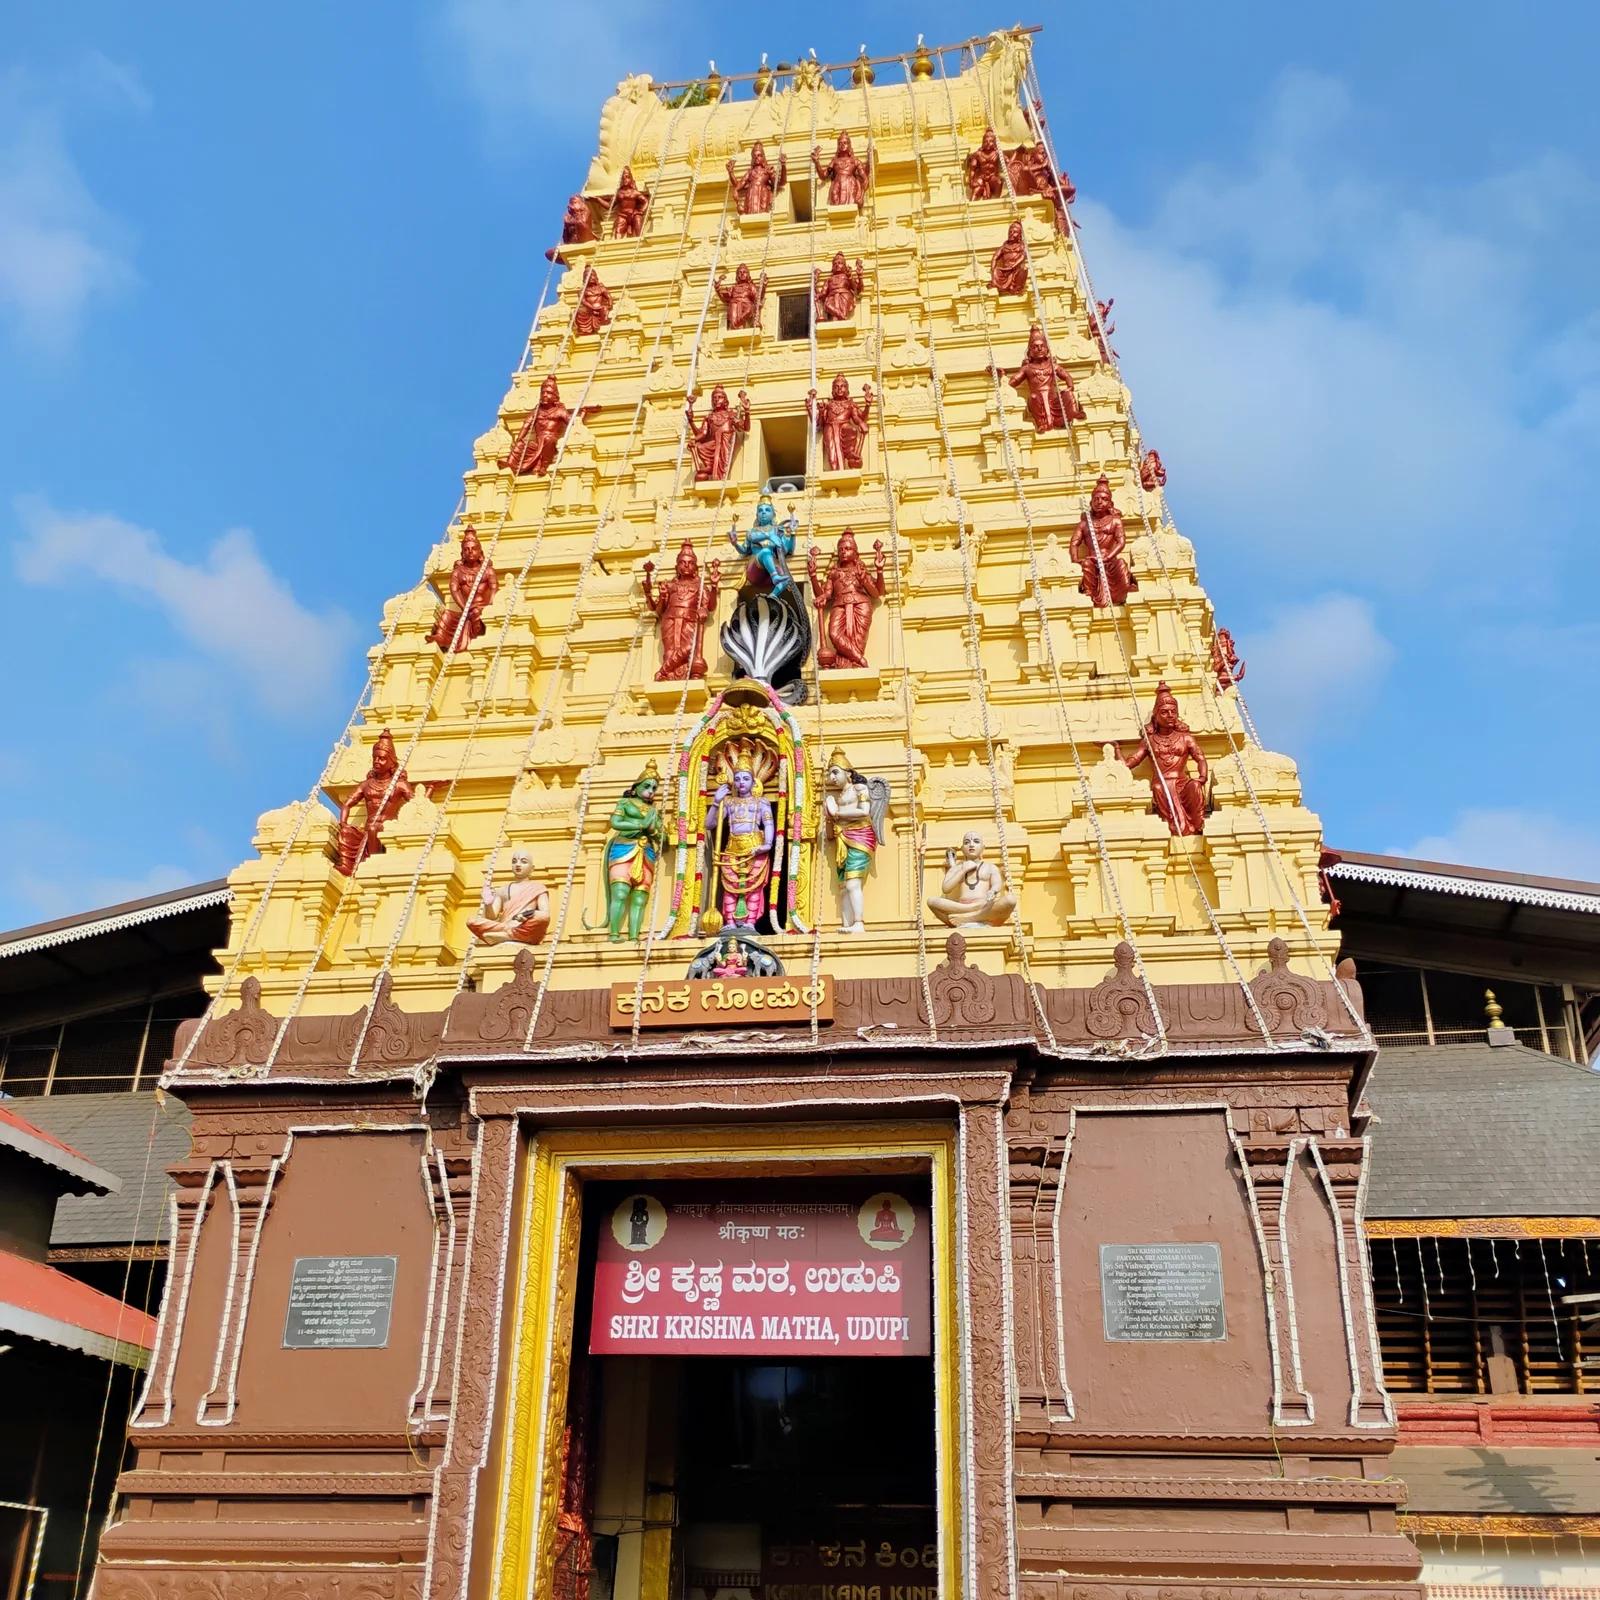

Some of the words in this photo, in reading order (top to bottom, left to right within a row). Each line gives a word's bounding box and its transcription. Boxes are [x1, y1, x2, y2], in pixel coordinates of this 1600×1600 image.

[616, 985, 692, 1014] ಕನಕ
[701, 979, 827, 1011] ಗೋಪುರ
[718, 1221, 771, 1243] श्रीकृष्ण
[621, 1260, 661, 1304] ಶ್ರೀ
[671, 1258, 723, 1311] ಕೃಷ್ಣ
[732, 1259, 796, 1296] ಮಠ,
[805, 1259, 900, 1293] ಉಡುಪಿ
[610, 1316, 658, 1339] SHRI
[664, 1316, 755, 1340] KRISHNA
[761, 1317, 840, 1345] MATHA,
[847, 1317, 910, 1341] UDUPI
